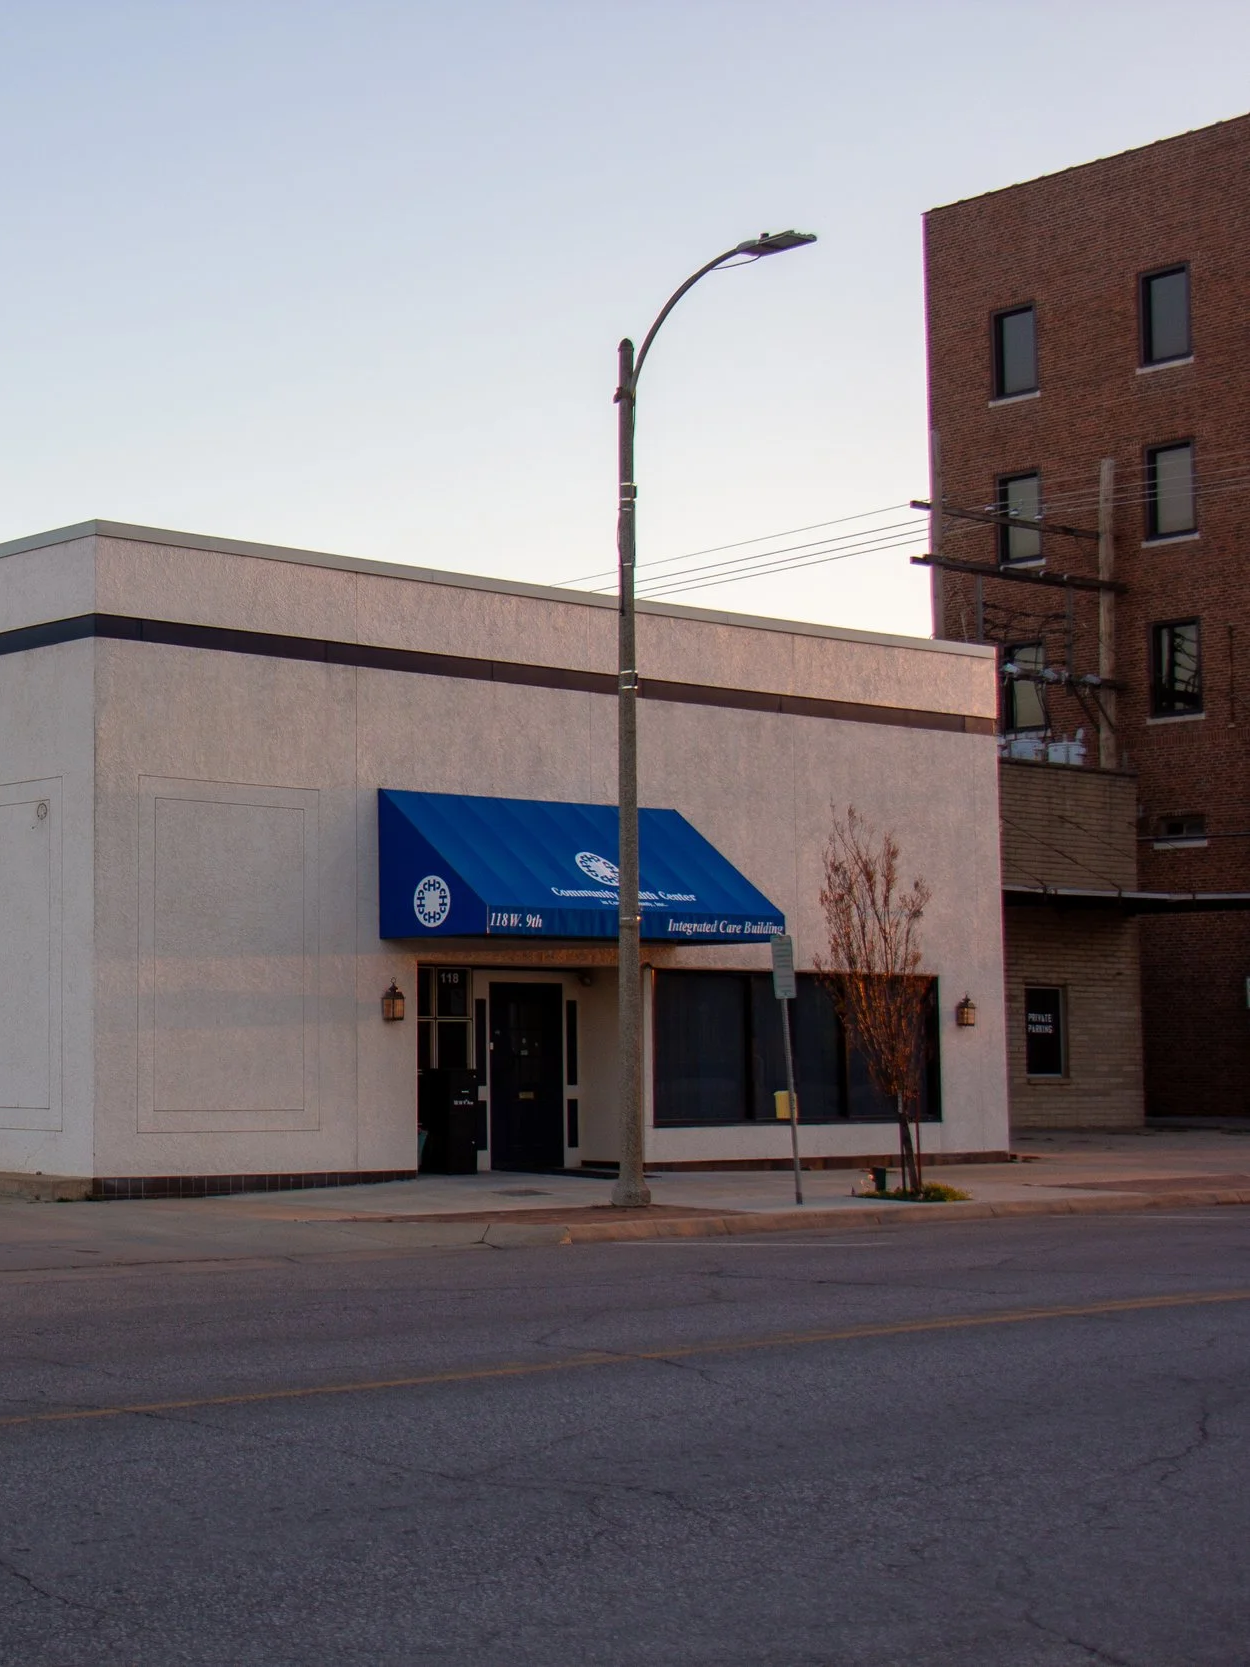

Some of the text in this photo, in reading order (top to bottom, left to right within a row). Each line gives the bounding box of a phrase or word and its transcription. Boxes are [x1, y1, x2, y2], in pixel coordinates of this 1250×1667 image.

[551, 886, 619, 901] Community
[658, 890, 697, 902] Center
[526, 913, 543, 928] 9th
[668, 919, 784, 935] Integrated Care Building
[440, 972, 459, 984] 118
[1028, 1013, 1052, 1022] PRIVATE
[1028, 1024, 1053, 1034] PARKING
